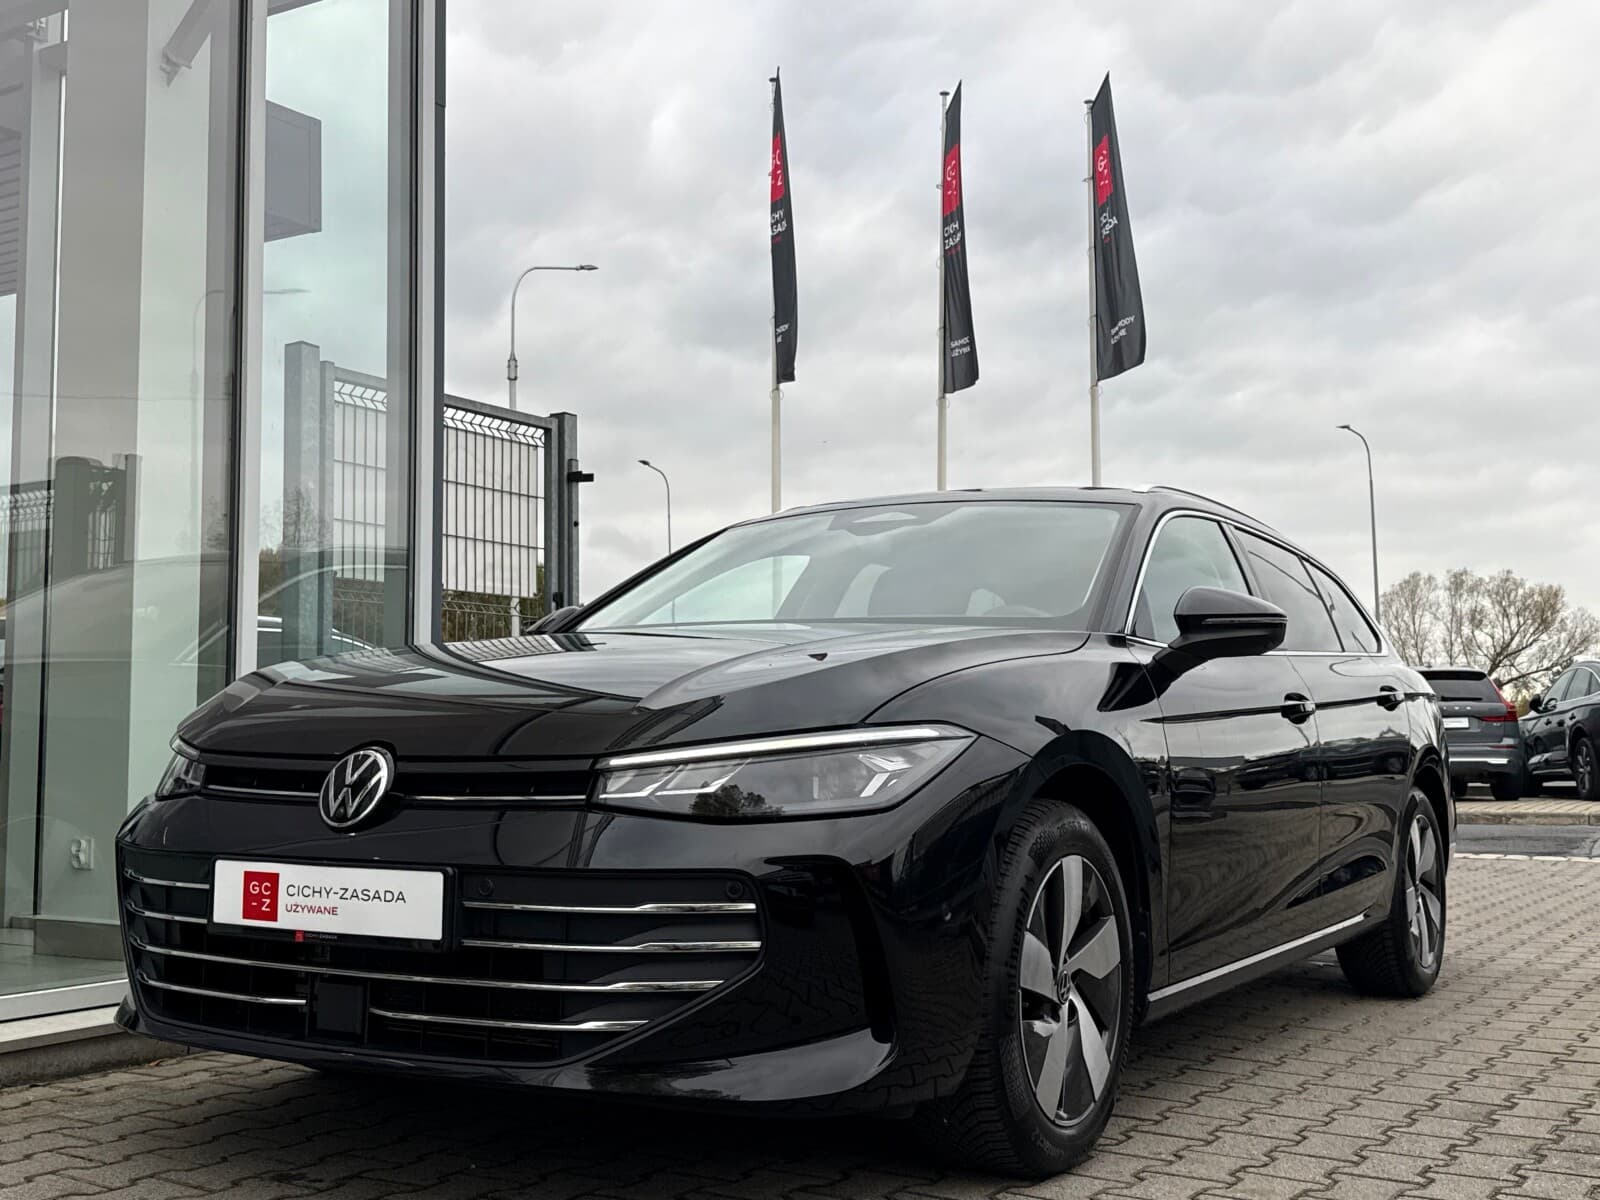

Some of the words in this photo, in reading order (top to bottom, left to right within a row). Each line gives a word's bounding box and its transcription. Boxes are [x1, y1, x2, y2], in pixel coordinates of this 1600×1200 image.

[249, 881, 272, 895] GC
[286, 884, 407, 904] CICHY-ZASADA
[285, 903, 339, 916] UŻYWANE
